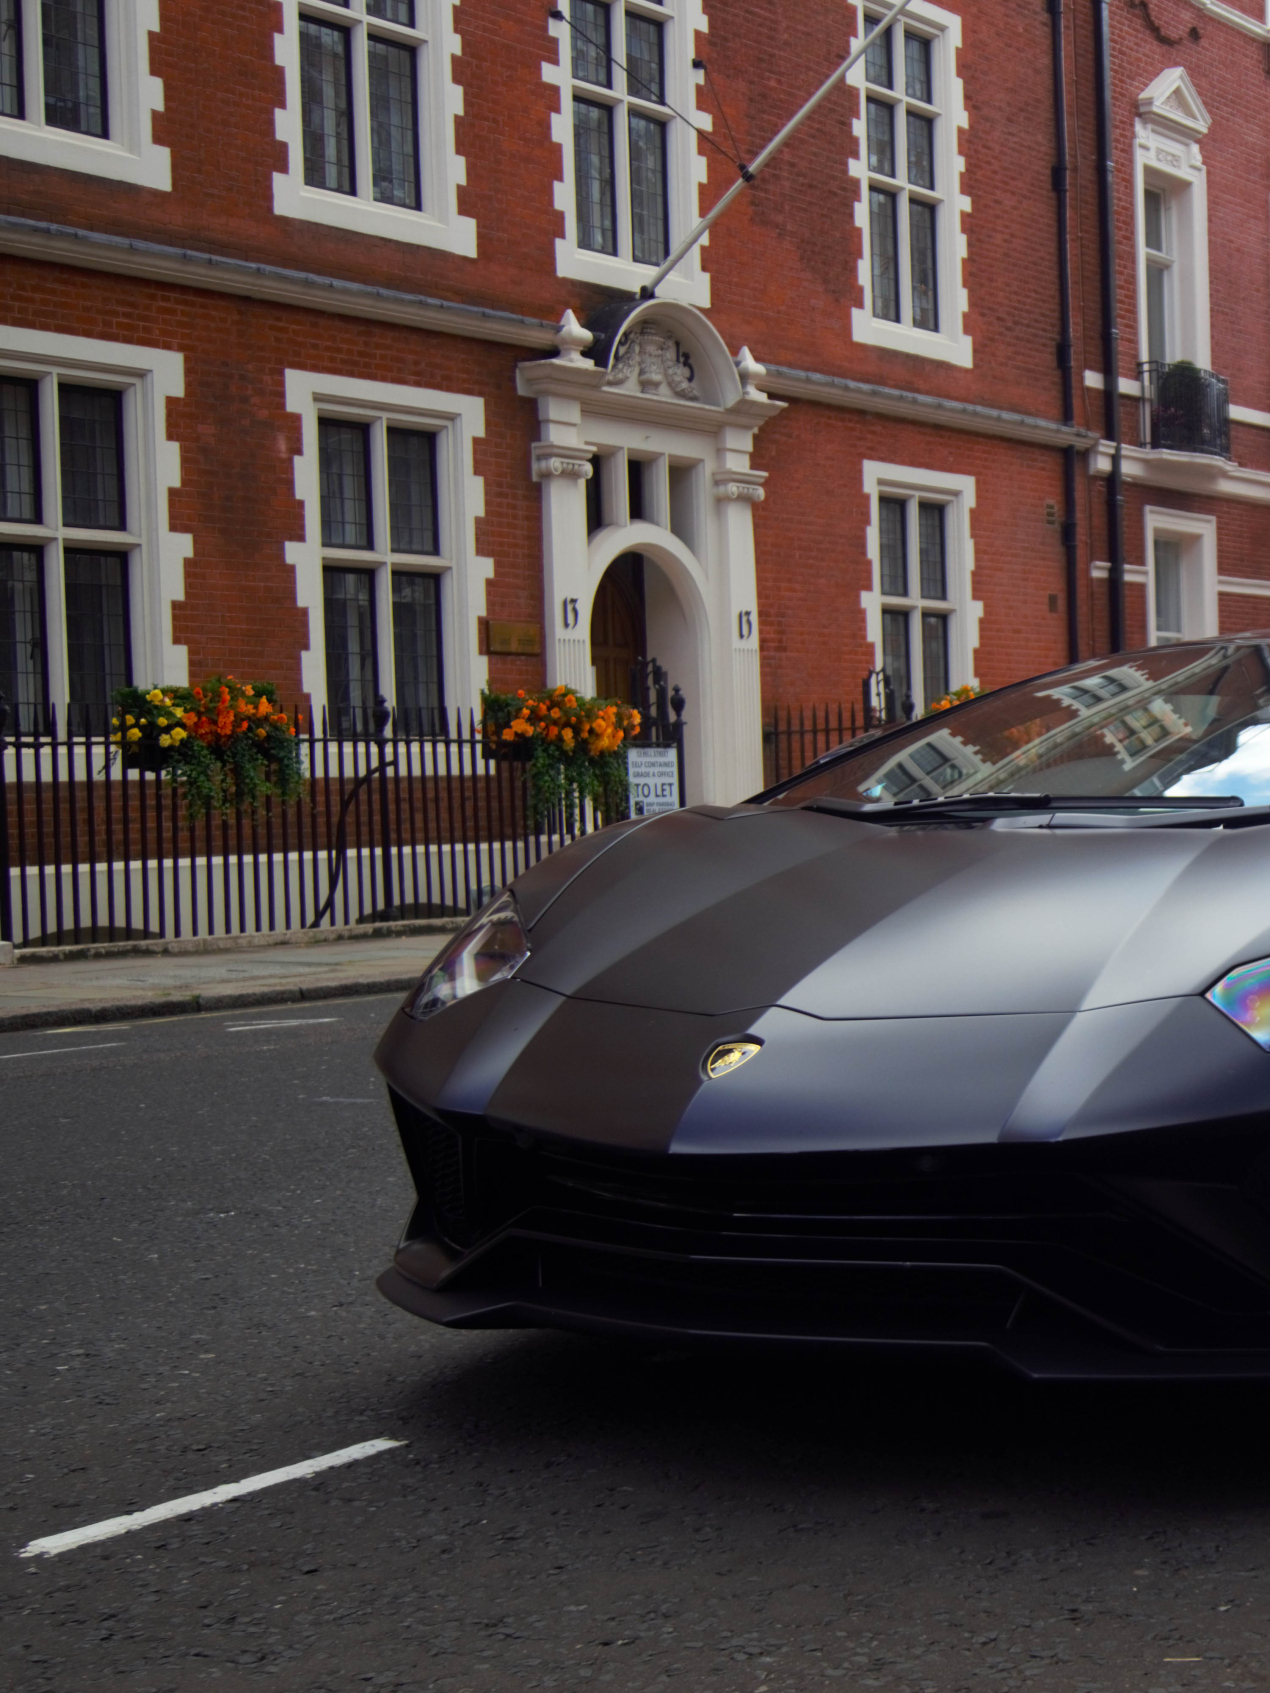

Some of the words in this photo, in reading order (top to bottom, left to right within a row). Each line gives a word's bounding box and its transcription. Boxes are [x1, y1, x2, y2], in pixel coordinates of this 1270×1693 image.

[563, 596, 579, 630] 13
[738, 610, 752, 639] 13
[634, 783, 651, 798] TO
[655, 783, 674, 797] LET
